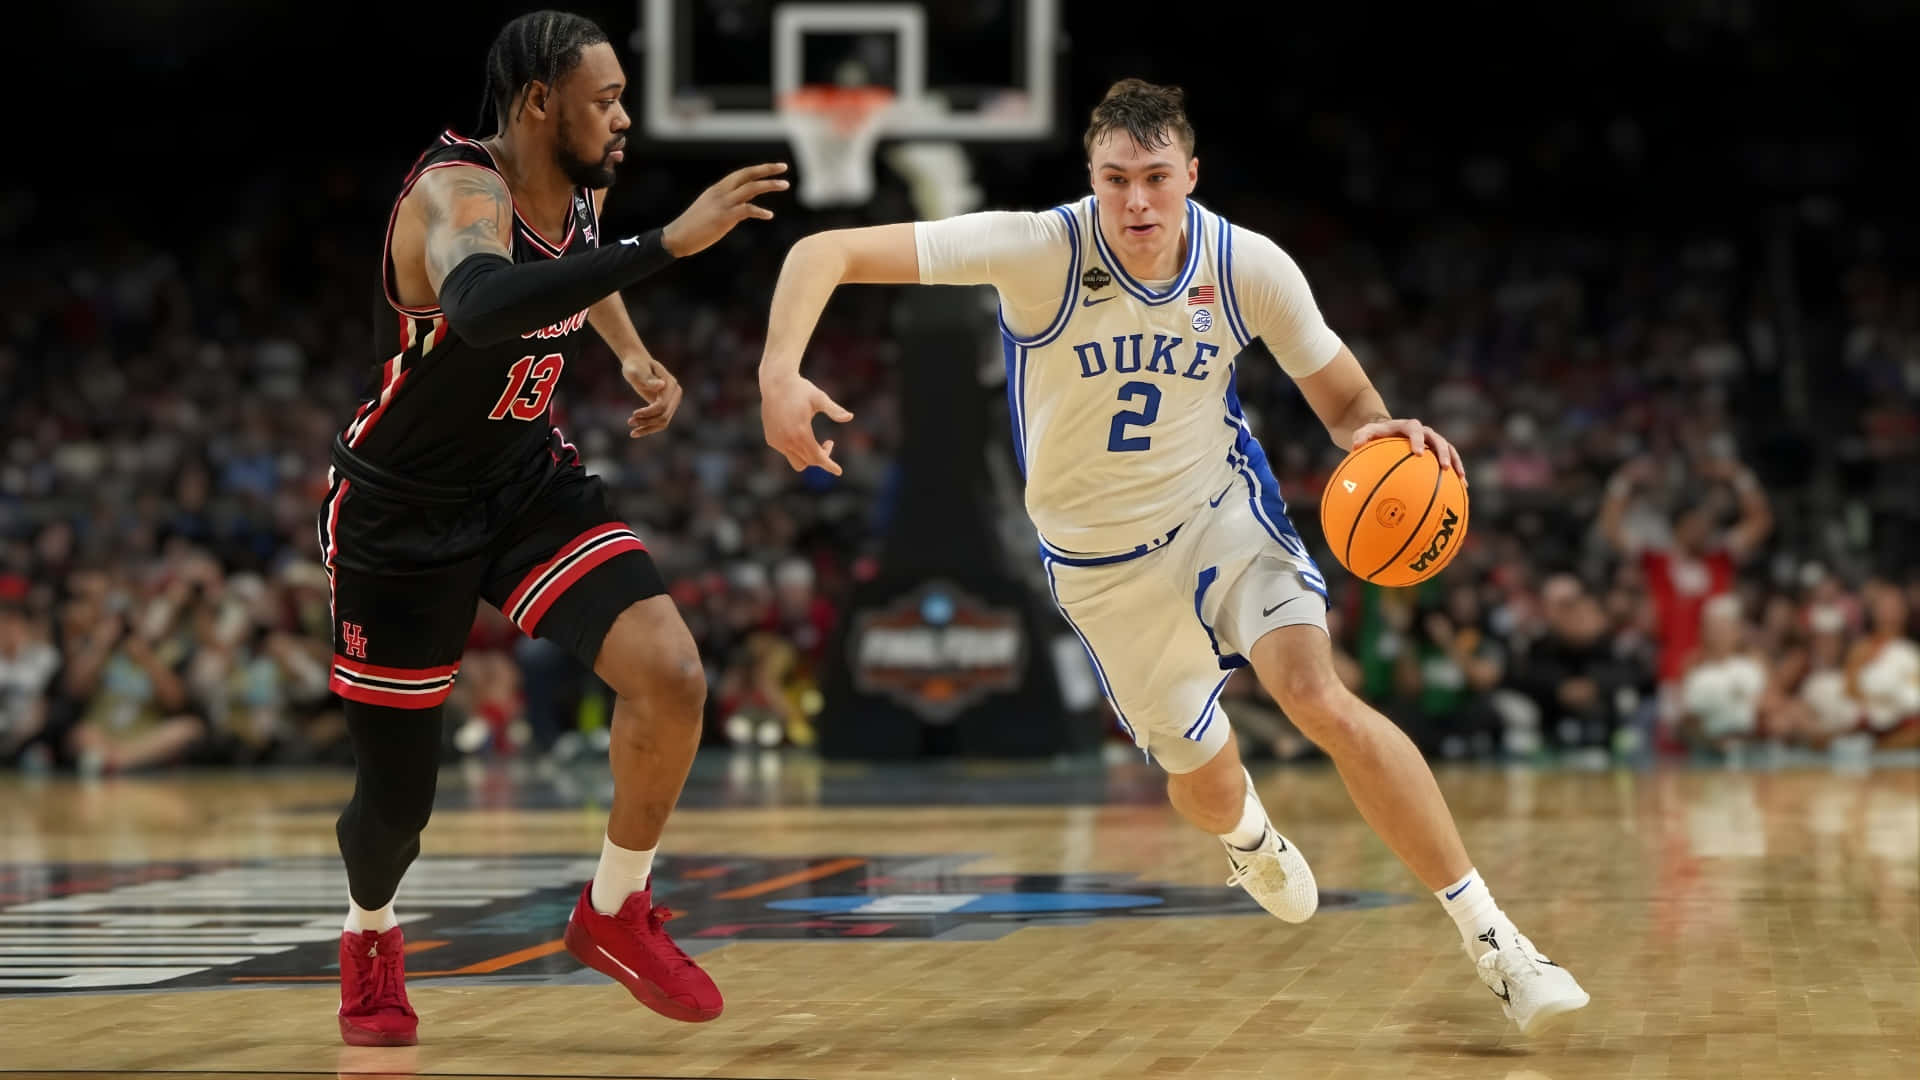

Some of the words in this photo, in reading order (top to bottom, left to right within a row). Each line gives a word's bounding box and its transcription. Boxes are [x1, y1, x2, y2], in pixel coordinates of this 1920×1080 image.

[488, 353, 564, 421] 13
[1073, 334, 1219, 380] DUKE
[1107, 381, 1162, 452] 2
[1410, 507, 1458, 572] NCAA
